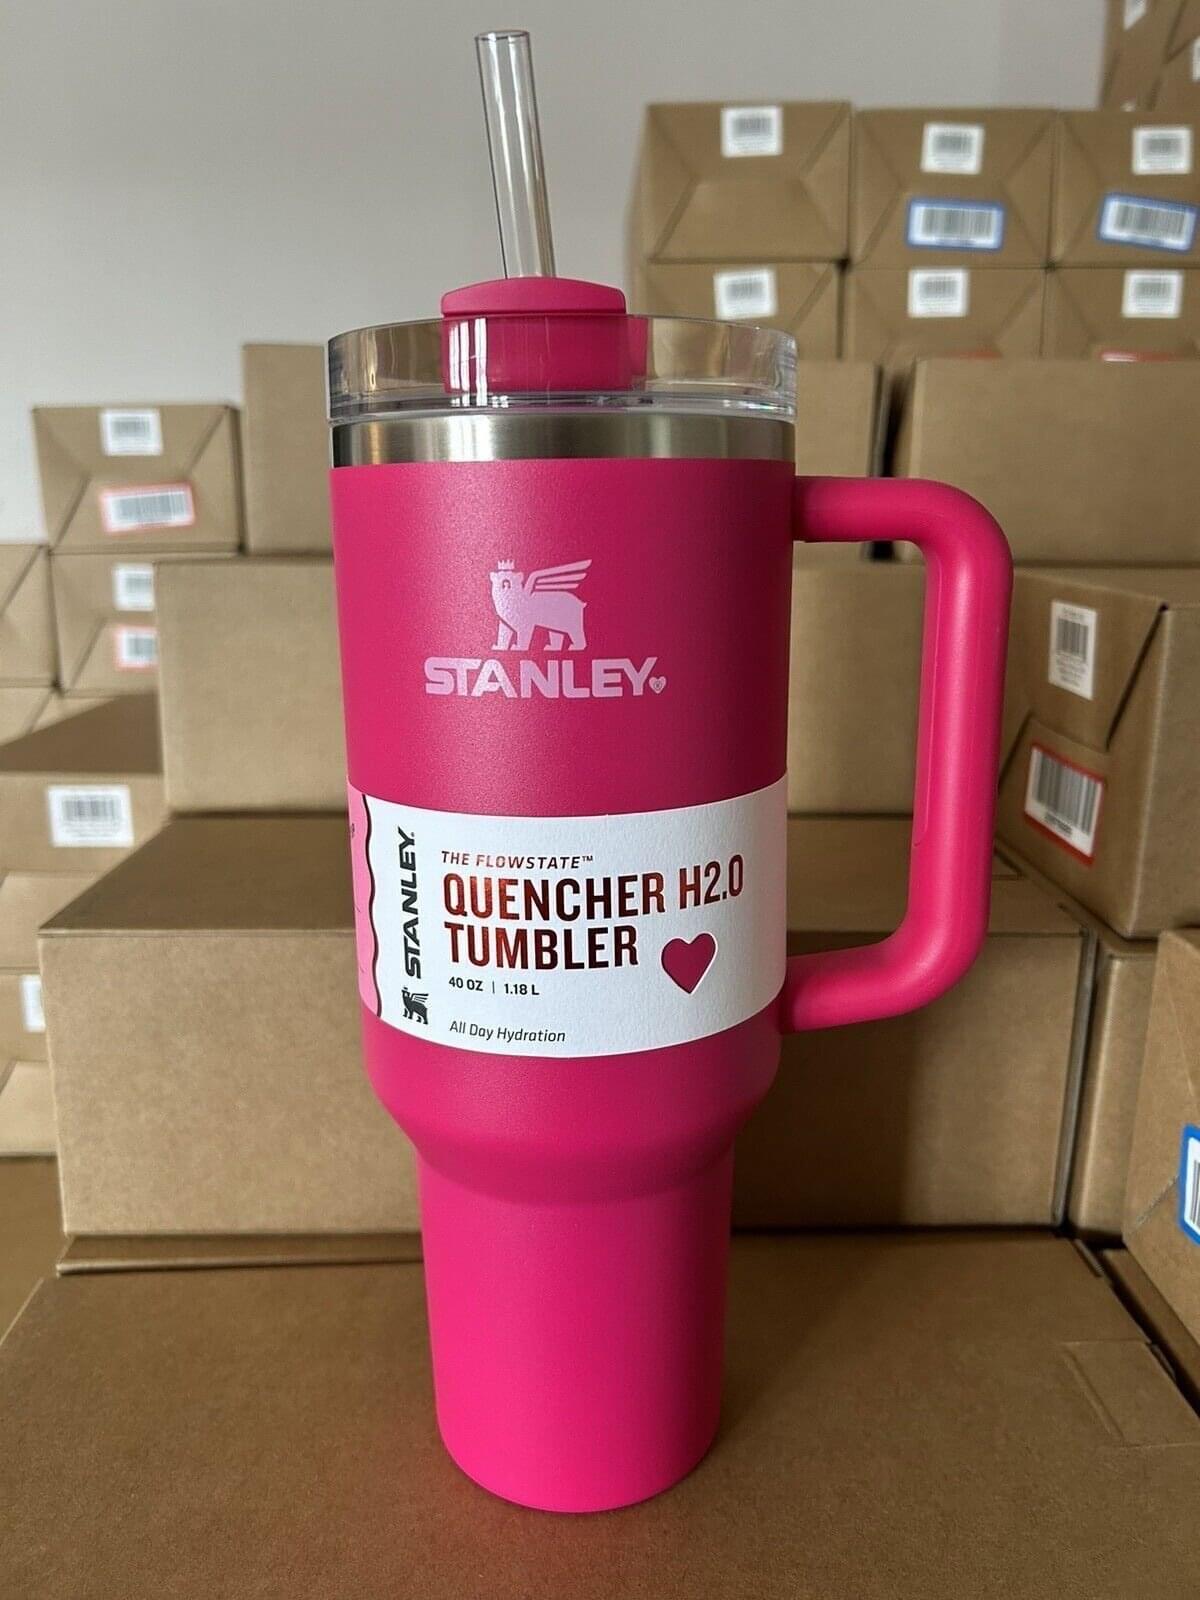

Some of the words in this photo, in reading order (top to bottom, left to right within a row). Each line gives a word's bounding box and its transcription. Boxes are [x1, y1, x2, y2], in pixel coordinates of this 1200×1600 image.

[424, 656, 658, 699] STANLEY
[441, 850, 471, 866] THE
[443, 872, 665, 922] QUENCHER
[679, 854, 744, 910] H2.0
[444, 921, 639, 971] TUMBLER
[448, 976, 464, 989] 40
[466, 979, 484, 991] OZ
[504, 983, 528, 995] 1.18
[531, 984, 540, 995] L
[449, 1020, 466, 1034] All
[469, 1023, 494, 1041] Day
[496, 1027, 566, 1043] Hydration
